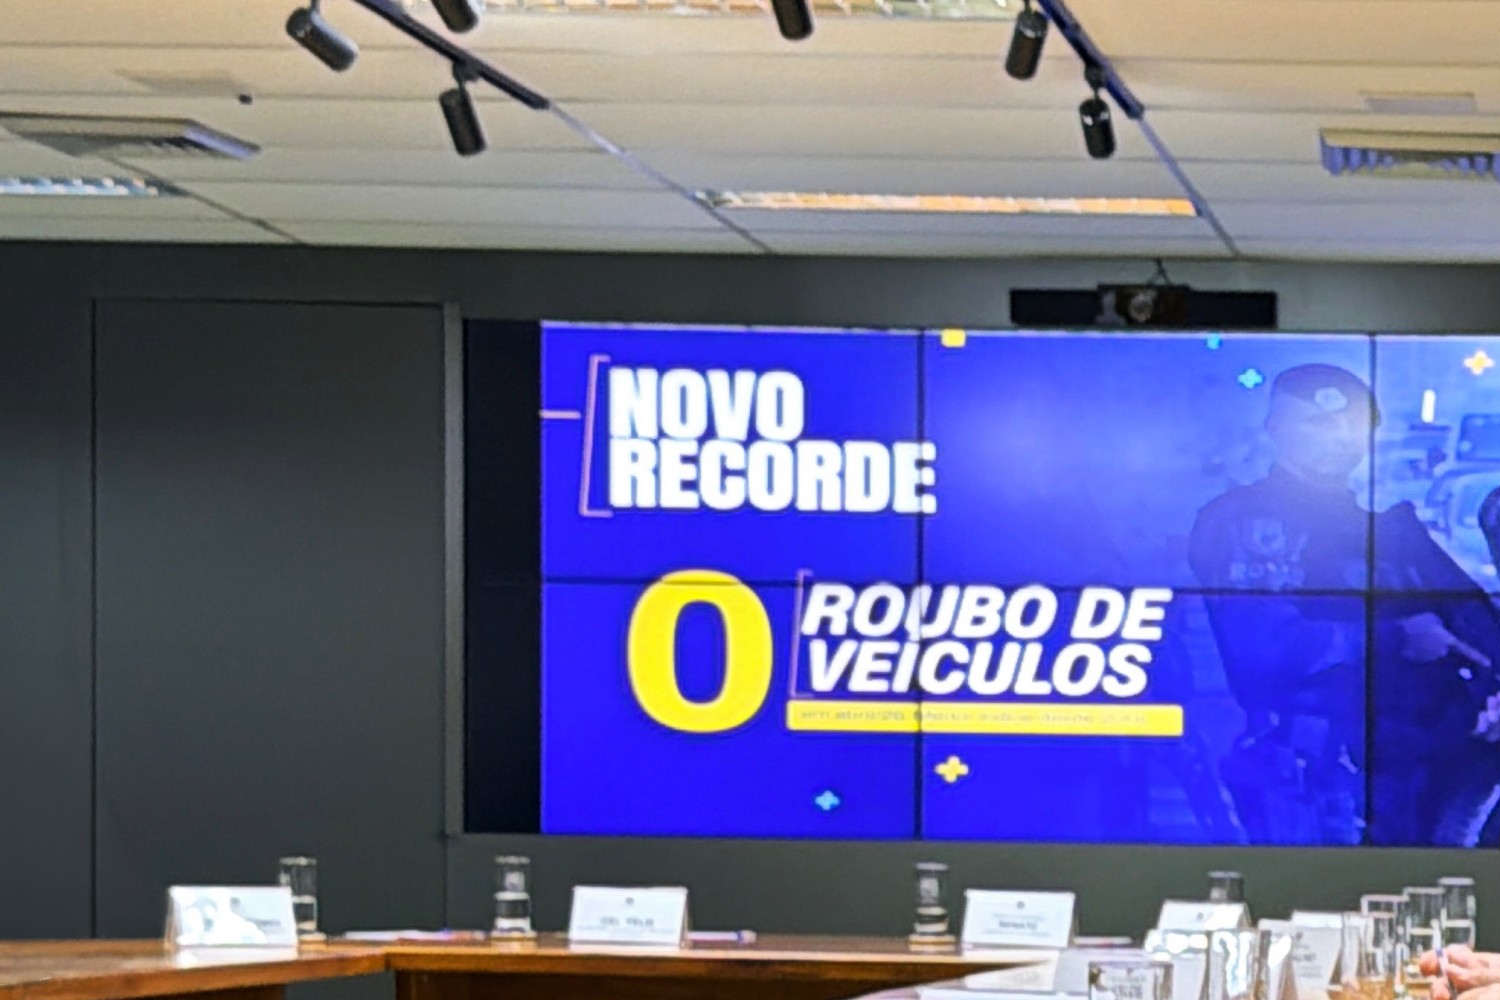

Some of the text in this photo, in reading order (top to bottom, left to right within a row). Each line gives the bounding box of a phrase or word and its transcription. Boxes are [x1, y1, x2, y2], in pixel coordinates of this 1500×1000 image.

[608, 367, 805, 441] NOVO
[608, 438, 937, 514] RECORDE
[801, 583, 1173, 641] ROUBO DE
